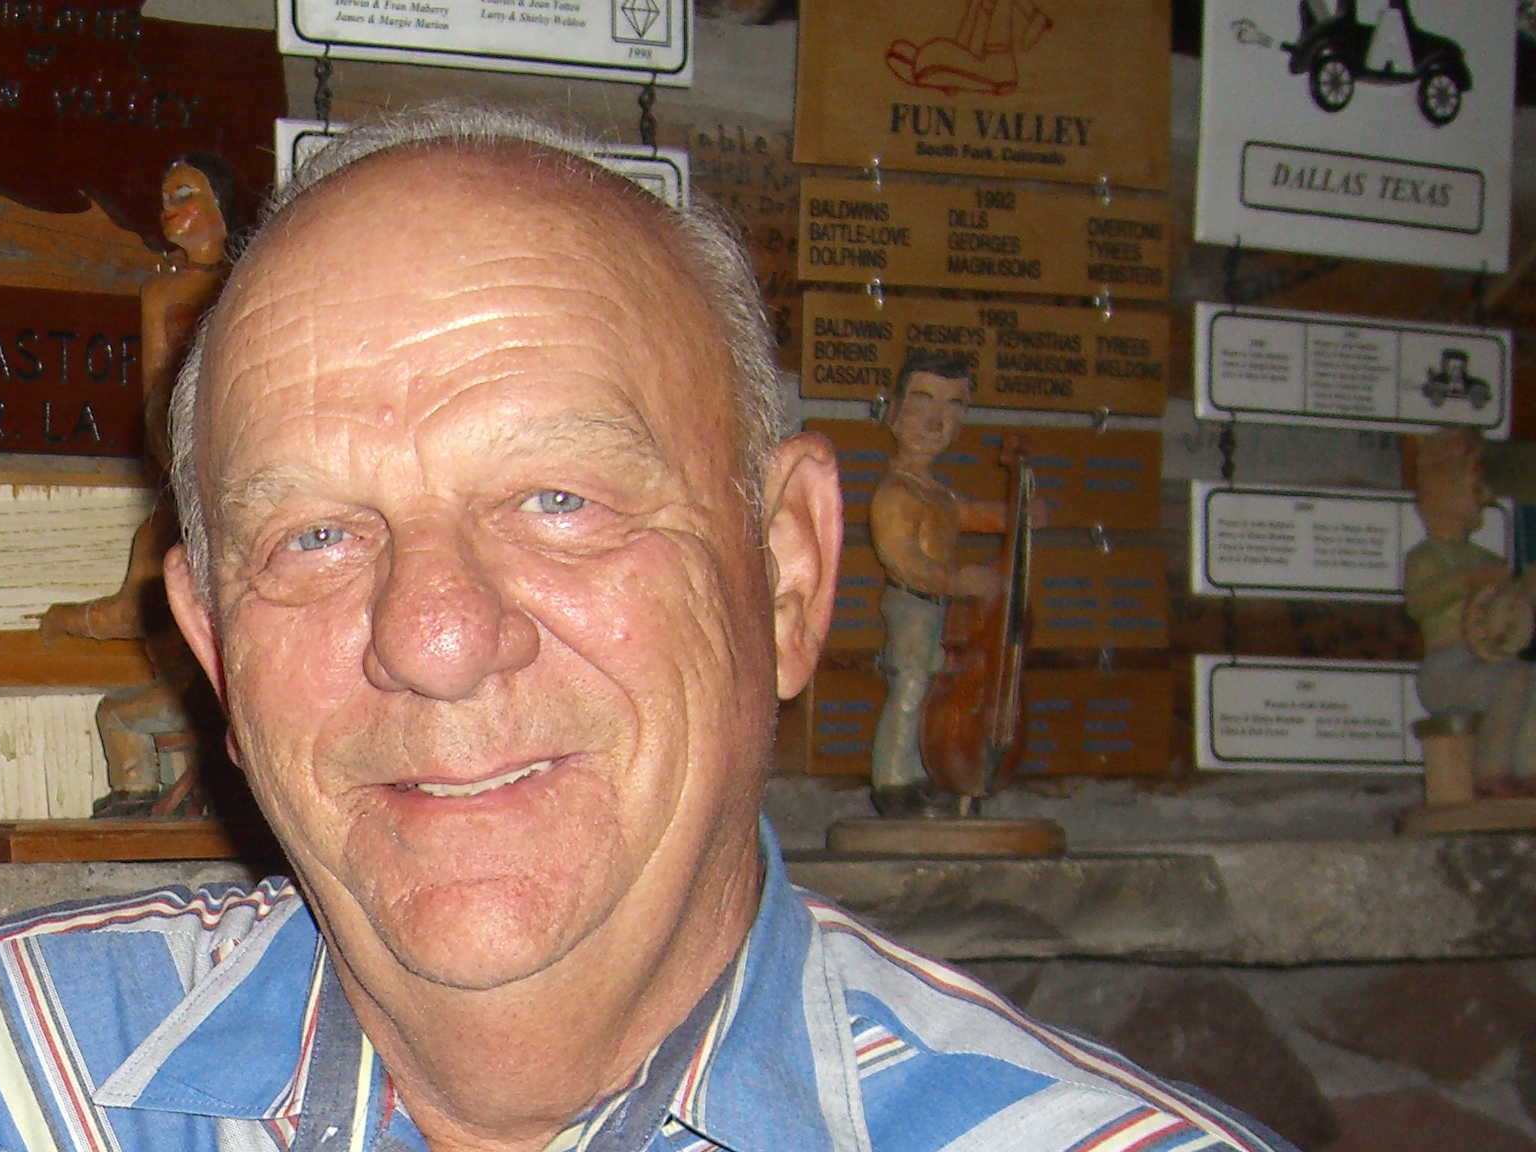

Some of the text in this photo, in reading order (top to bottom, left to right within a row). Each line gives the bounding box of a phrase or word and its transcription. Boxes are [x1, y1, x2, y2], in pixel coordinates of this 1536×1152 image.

[335, 11, 365, 23] James
[367, 14, 375, 24] &
[480, 9, 505, 22] Larry
[508, 11, 516, 21] &
[53, 84, 201, 129] VALLEY
[889, 102, 1097, 147] FUN VALLEY
[916, 141, 958, 157] South
[1002, 146, 1067, 166] Colorado
[1271, 161, 1453, 208] DALLAS TEXAS
[810, 198, 889, 222] BALDWINS
[948, 208, 988, 230] DILLS
[810, 223, 912, 247] BATTLE-LOVE
[1088, 216, 1163, 242] OVERTONS
[948, 232, 1020, 254] GEORGES
[809, 246, 887, 269] DOLPHINS
[948, 255, 1042, 280] MAGNUSONS
[814, 317, 893, 340] BALDWINS
[906, 323, 985, 347] CHESNEYS
[996, 351, 1087, 376] MAGNUSONS
[814, 365, 893, 389] CASSATTS
[996, 376, 1074, 398] OVERTONS
